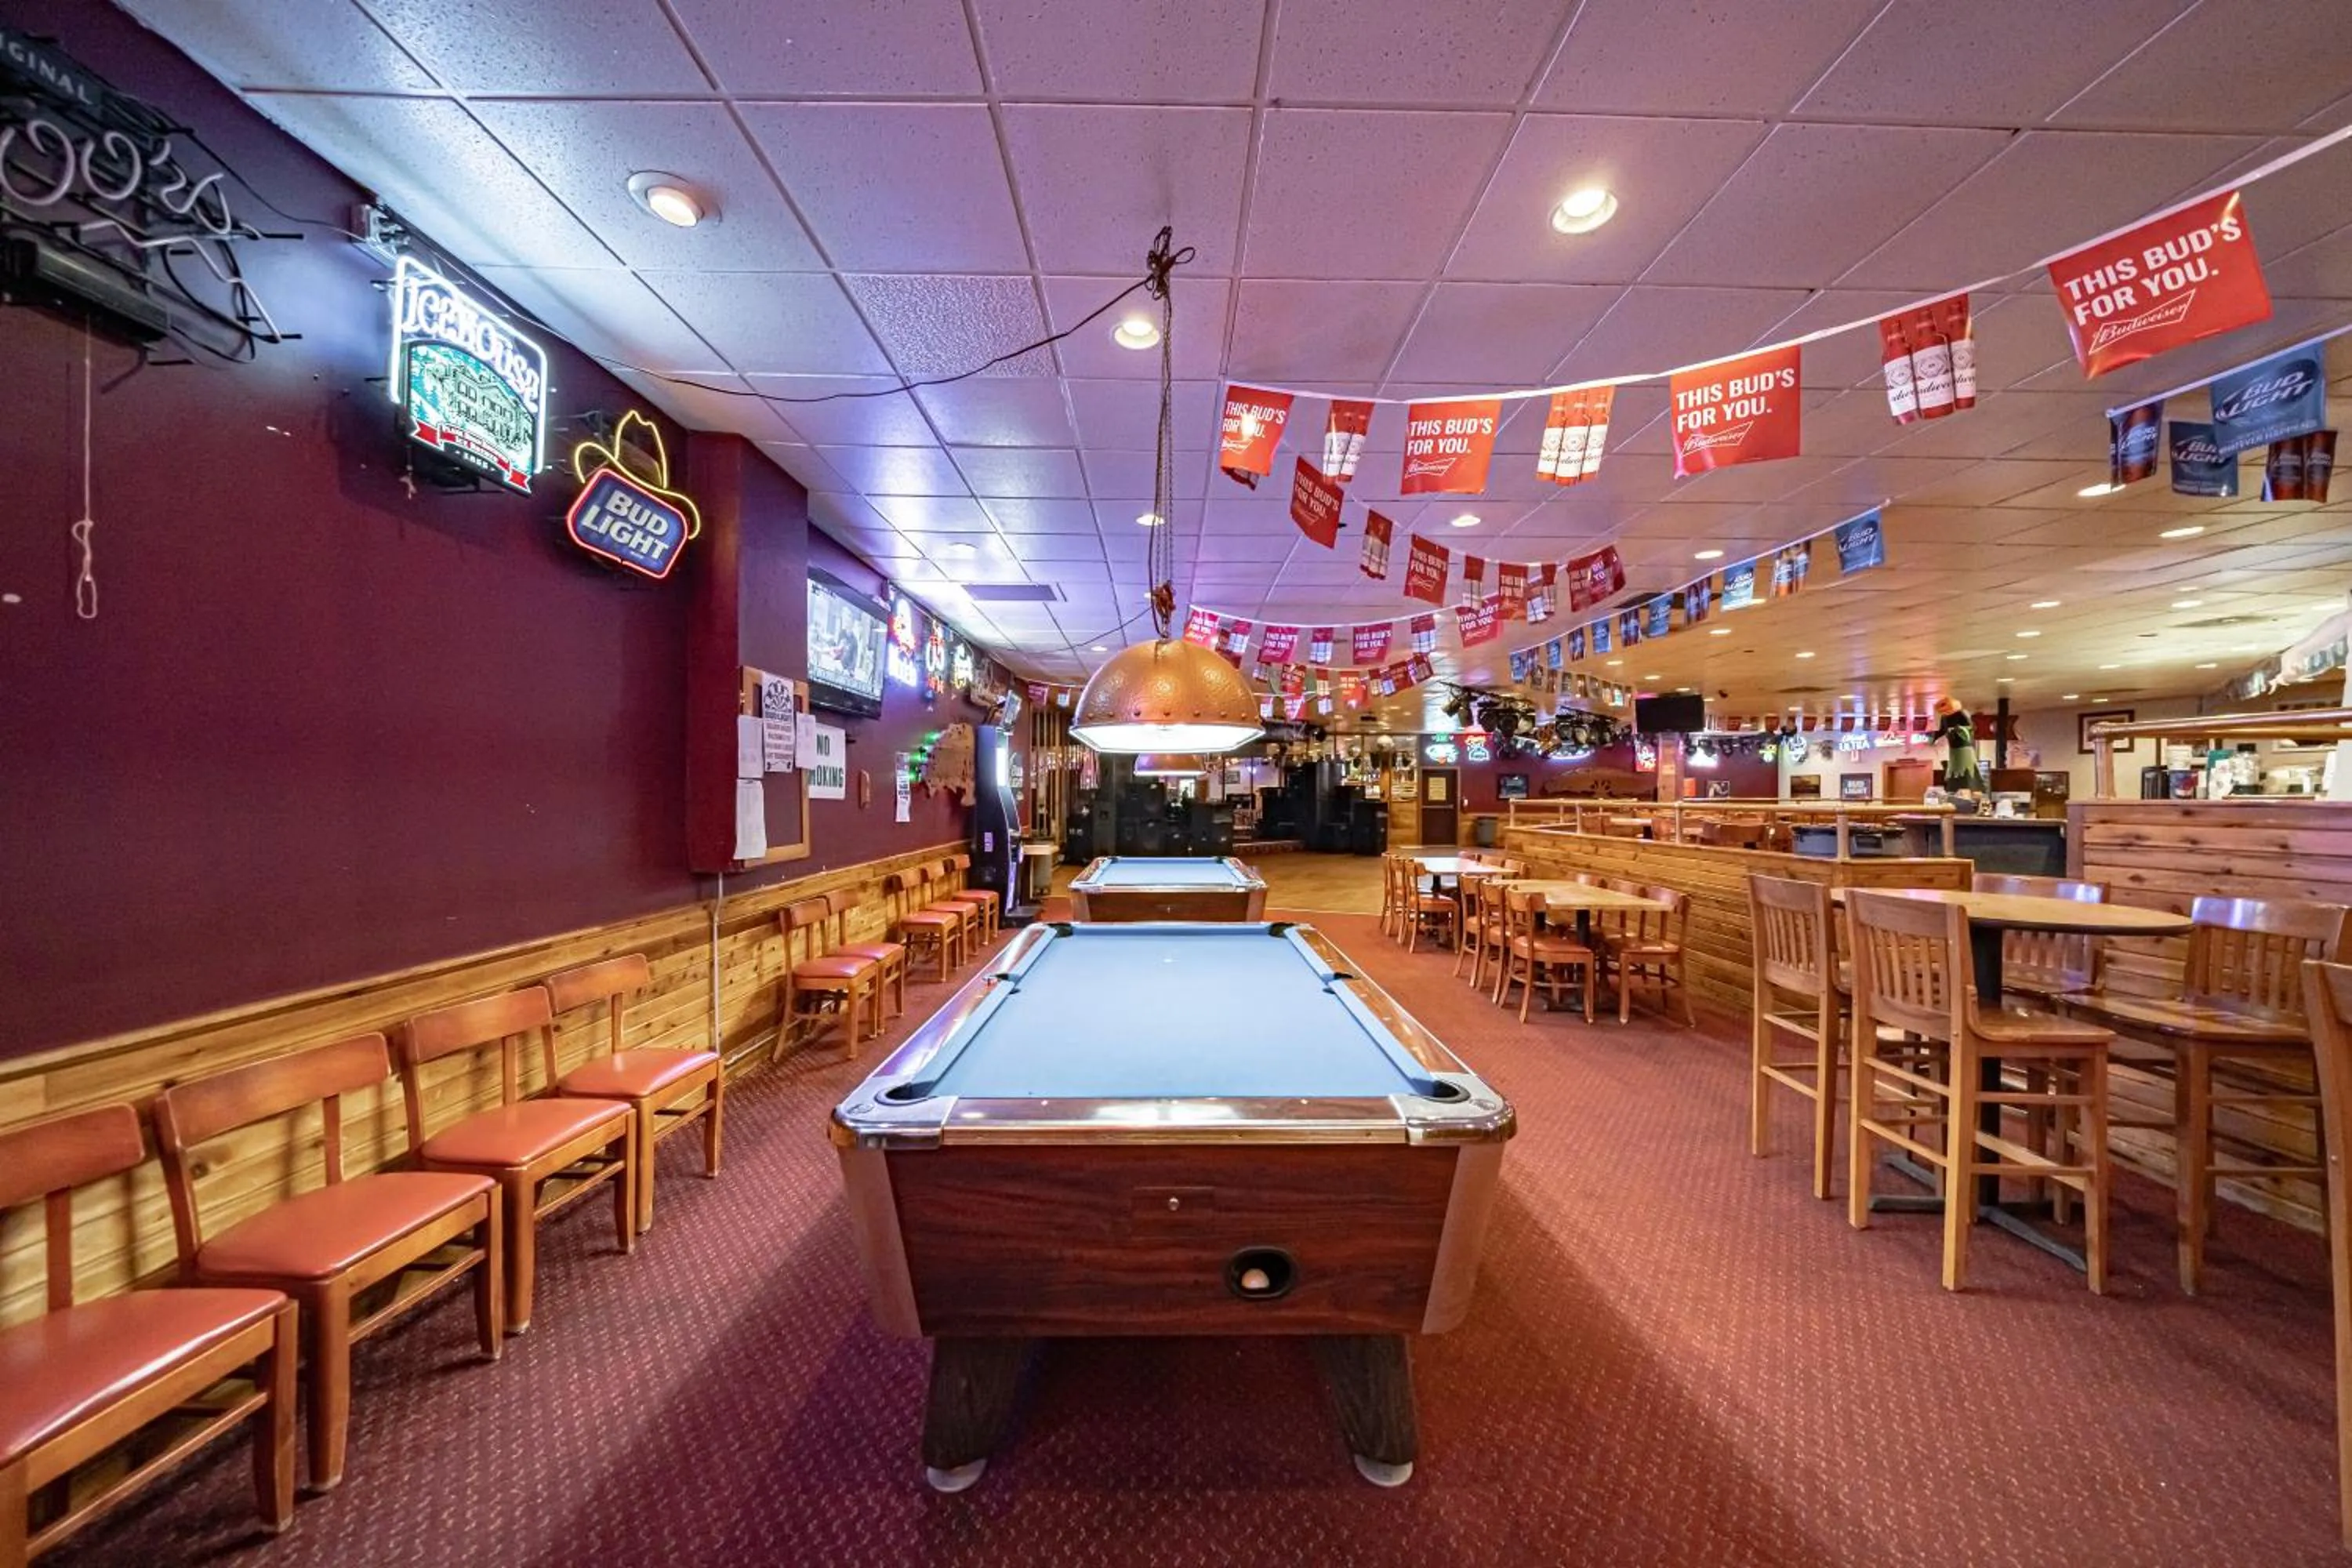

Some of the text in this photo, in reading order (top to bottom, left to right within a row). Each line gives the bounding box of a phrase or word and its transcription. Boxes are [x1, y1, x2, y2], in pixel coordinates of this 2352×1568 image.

[2063, 216, 2241, 300] THIS BUD'S
[2073, 257, 2220, 326] FOR YOU.
[2095, 303, 2187, 343] Budweiser
[1676, 368, 1795, 411] THIS BUD'S
[2227, 379, 2314, 417] LIGHT
[2241, 371, 2305, 401] BUD
[1222, 418, 1240, 432] FOR
[1225, 401, 1287, 424] THIS BUD'S
[1410, 417, 1493, 436] THIS BUD'S
[1677, 396, 1772, 434] FOR YOU.
[1407, 437, 1472, 456] FOR YOU.
[1294, 484, 1308, 505] FOR
[1309, 496, 1327, 518] YOU.
[1296, 472, 1339, 511] THIS BUD'S
[582, 504, 670, 559] LIGHT
[604, 490, 669, 535] BUD
[816, 734, 830, 757] NO
